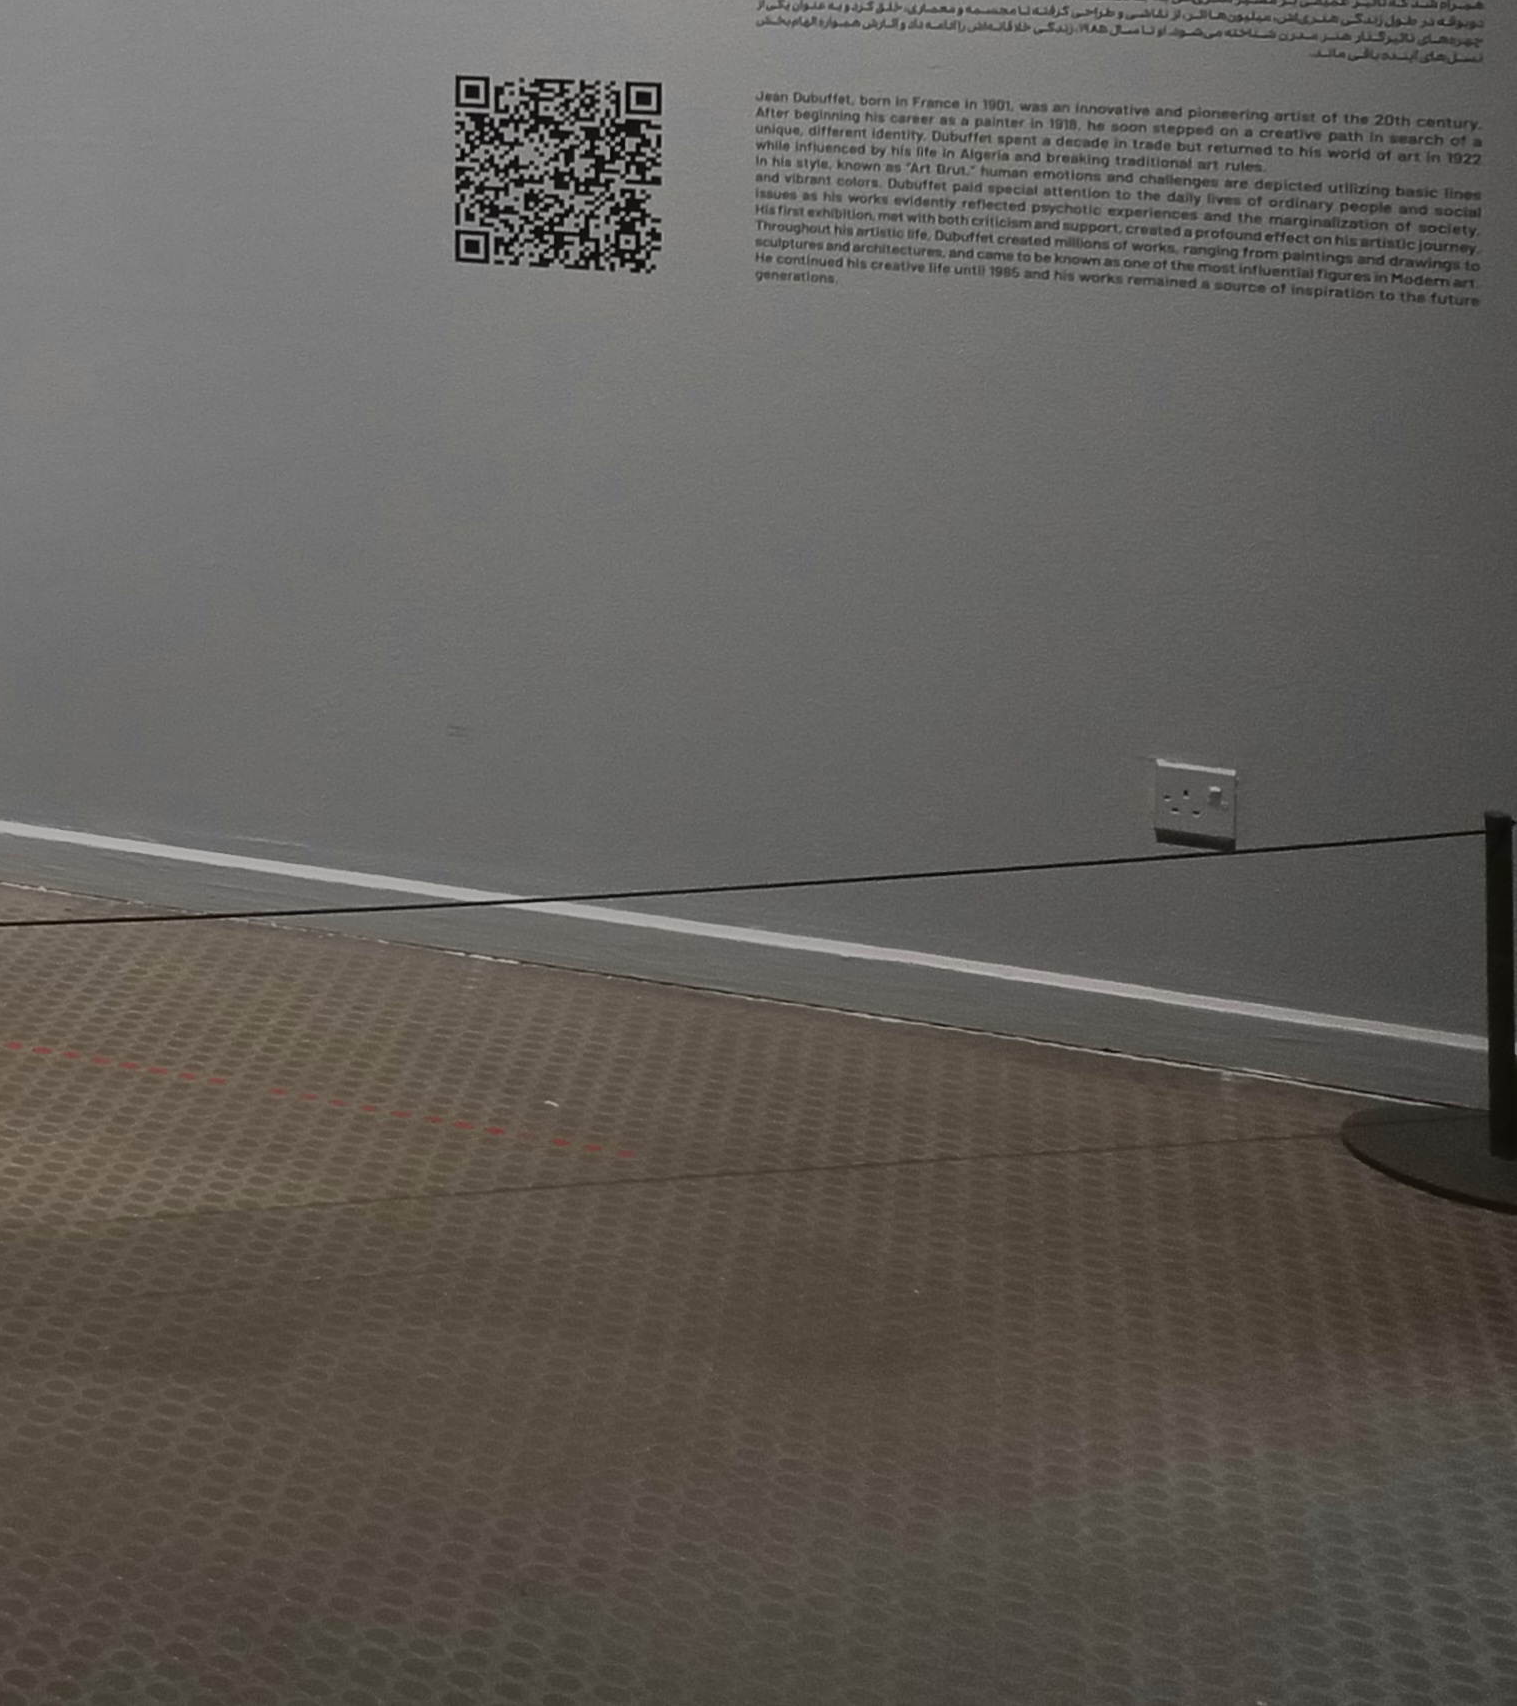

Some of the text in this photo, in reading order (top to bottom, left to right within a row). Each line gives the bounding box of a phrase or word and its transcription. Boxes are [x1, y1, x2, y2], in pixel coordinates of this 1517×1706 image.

[755, 91, 788, 102] Jean
[859, 95, 891, 106] born
[894, 96, 908, 107] in
[911, 97, 960, 109] France
[964, 99, 977, 109] in
[1019, 103, 1048, 112] was
[1051, 104, 1070, 113] an
[1074, 103, 1150, 116] innovative
[1154, 106, 1182, 117] and
[1187, 107, 1269, 122] pioneering
[1273, 110, 1315, 122] artist
[1321, 112, 1337, 123] of
[1343, 113, 1369, 124] the
[1374, 114, 1410, 126] 20th
[755, 107, 789, 118] After
[793, 109, 860, 123] beginning
[864, 111, 885, 122] his
[889, 115, 933, 124] career
[939, 116, 955, 125] as
[960, 117, 969, 126] a
[974, 116, 1024, 129] painter
[1029, 118, 1043, 129] in
[1086, 120, 1105, 131] he
[1110, 123, 1147, 133] soon
[1152, 123, 1214, 137] stepped
[1219, 127, 1238, 136] on
[1243, 128, 1253, 137] a
[1258, 127, 1322, 140] creative
[1327, 130, 1363, 143] path
[1369, 131, 1384, 142] in
[1388, 132, 1444, 145] search
[1449, 134, 1466, 146] of
[1472, 137, 1483, 146] a
[755, 140, 790, 151] while
[794, 141, 866, 154] influenced
[870, 145, 886, 157] by
[890, 145, 911, 156] his
[915, 146, 937, 157] life
[941, 148, 955, 158] in
[960, 148, 1010, 162] Algeria
[1014, 151, 1041, 162] and
[1045, 152, 1110, 167] breaking
[1114, 155, 1192, 169] traditional
[1196, 159, 1218, 170] art
[808, 126, 866, 138] different
[931, 131, 992, 143] Dubuffet
[996, 133, 1036, 147] spent
[1041, 137, 1051, 146] a
[1055, 136, 1109, 148] decade
[1113, 138, 1127, 149] in
[1132, 139, 1171, 151] trade
[1176, 141, 1201, 152] but
[1206, 142, 1273, 155] returned
[1277, 145, 1294, 156] to
[1298, 146, 1321, 157] his
[1326, 147, 1371, 159] world
[1375, 149, 1391, 160] of
[1396, 150, 1420, 161] art
[1425, 151, 1441, 162] in
[755, 156, 767, 166] In
[771, 156, 791, 167] his
[836, 159, 881, 171] known
[885, 164, 901, 172] as
[979, 166, 1028, 178] human
[1032, 168, 1101, 182] emotions
[1106, 172, 1134, 183] and
[1138, 173, 1218, 189] challenges
[1223, 179, 1248, 188] are
[1253, 178, 1322, 193] depicted
[1327, 182, 1390, 197] utilizing
[1394, 185, 1438, 197] basic
[1443, 187, 1481, 199] lines
[755, 172, 780, 183] and
[784, 173, 831, 185] vibrant
[887, 178, 946, 191] Dubuffet
[951, 181, 983, 194] paid
[987, 183, 1038, 197] special
[1043, 186, 1110, 199] attention
[1115, 189, 1131, 200] to
[1136, 190, 1160, 201] the
[1166, 191, 1201, 205] daily
[1206, 193, 1241, 205] lives
[1246, 195, 1262, 206] of
[1268, 196, 1333, 211] ordinary
[1339, 200, 1392, 214] people
[1398, 202, 1428, 214] and
[1433, 204, 1482, 217] social
[754, 188, 797, 200] issues
[801, 192, 817, 201] as
[822, 191, 842, 202] his
[847, 193, 888, 205] works
[893, 195, 956, 209] evidently
[961, 198, 1026, 211] reflected
[1030, 202, 1101, 217] psychotic
[1107, 205, 1197, 222] experiences
[1203, 210, 1232, 222] and
[1237, 212, 1262, 223] the
[1268, 213, 1389, 231] marginalization
[1394, 220, 1411, 231] of
